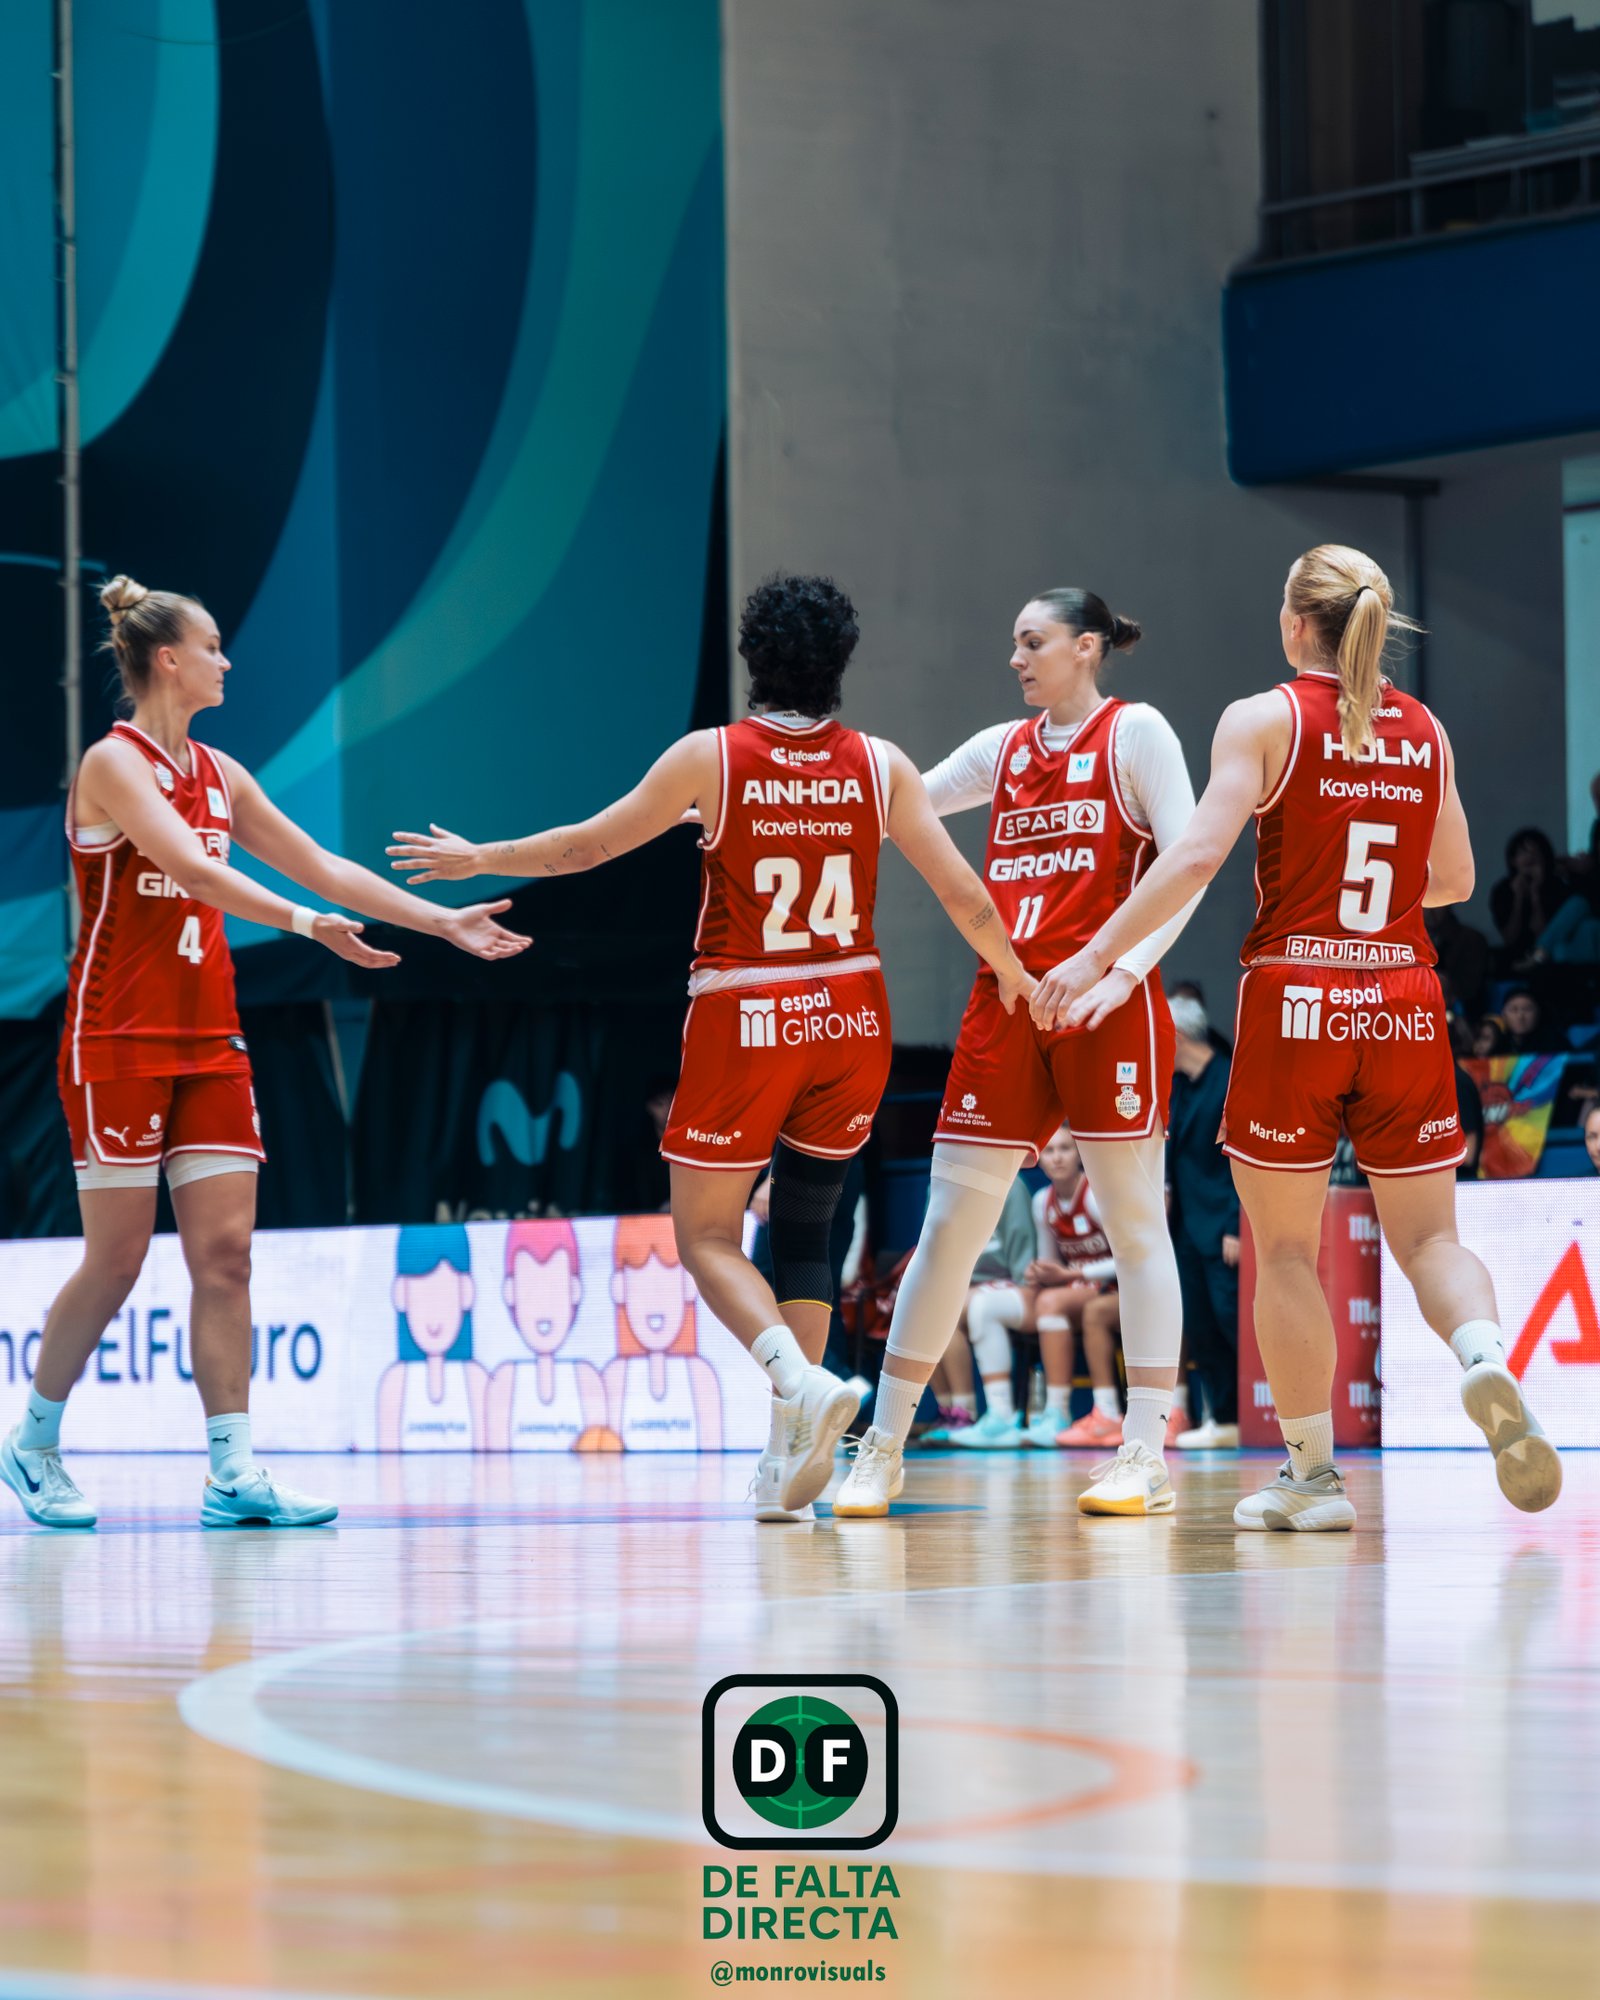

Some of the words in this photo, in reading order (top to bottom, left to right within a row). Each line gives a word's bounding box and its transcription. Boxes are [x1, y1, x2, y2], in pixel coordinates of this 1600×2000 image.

[1370, 707, 1402, 718] osoft
[788, 750, 831, 762] infosoft
[742, 779, 864, 804] AINHOA
[1320, 778, 1369, 799] Kave
[1371, 780, 1423, 803] Home
[752, 819, 798, 836] Kave
[798, 819, 853, 836] Home
[1004, 810, 1067, 838] SPAR
[988, 848, 1096, 882] GIRONA
[1337, 821, 1398, 933] 5
[753, 853, 861, 953] 24
[1011, 895, 1044, 940] 11
[177, 916, 203, 964] 4
[1290, 939, 1413, 963] BAUHAUS
[780, 987, 830, 1014] espai
[1329, 983, 1383, 1009] espai
[782, 1006, 880, 1046] GIRONÈS
[1326, 1006, 1435, 1041] GIRONÈS
[686, 1127, 732, 1145] Marlex
[1249, 1120, 1296, 1143] Marlex
